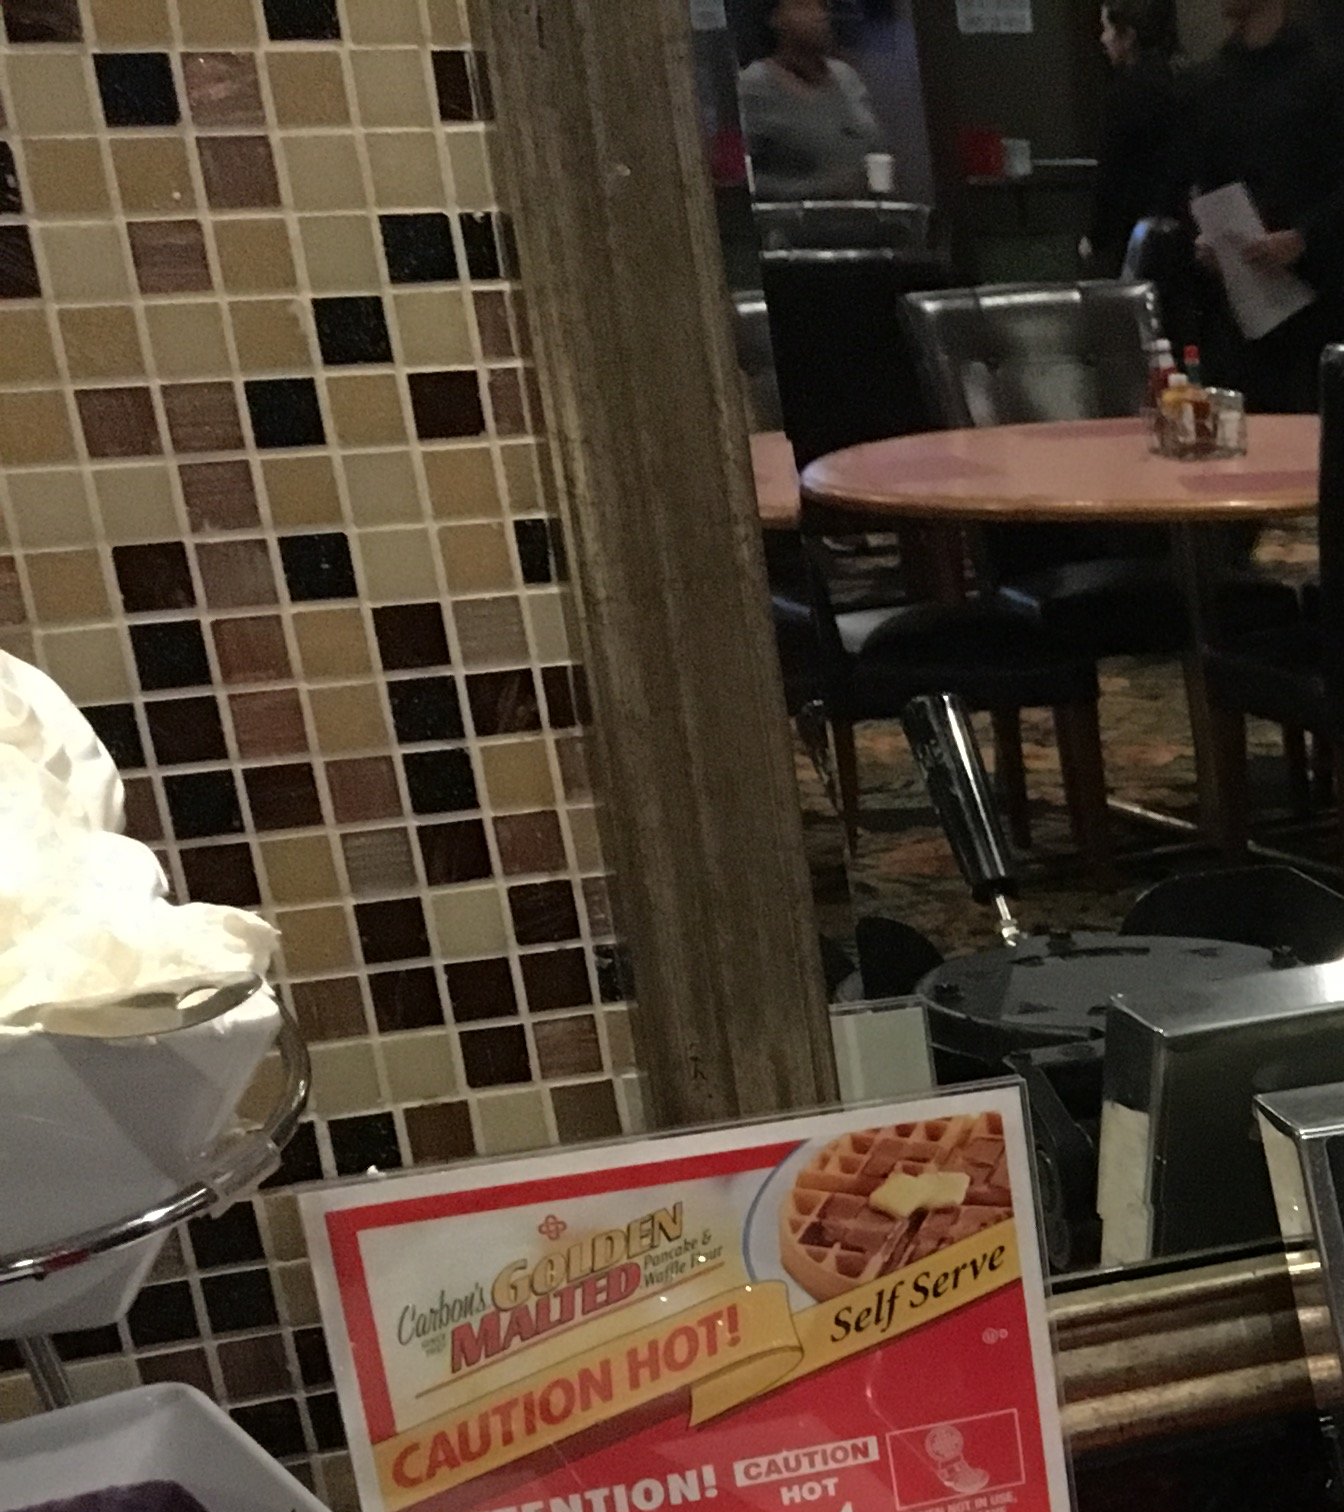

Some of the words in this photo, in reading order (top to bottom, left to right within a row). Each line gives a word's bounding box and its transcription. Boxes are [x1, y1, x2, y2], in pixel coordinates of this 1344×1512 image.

[398, 1281, 486, 1346] Carbon's
[491, 1200, 684, 1311] GOLDEN
[644, 1236, 698, 1270] Pancake
[451, 1261, 642, 1374] MALTED
[830, 1281, 905, 1343] Self
[909, 1244, 1005, 1309] Serve
[391, 1358, 614, 1489] CAUTION
[626, 1304, 742, 1391] HOT!
[743, 1440, 870, 1482] CAUTION
[780, 1477, 839, 1505] HOT
